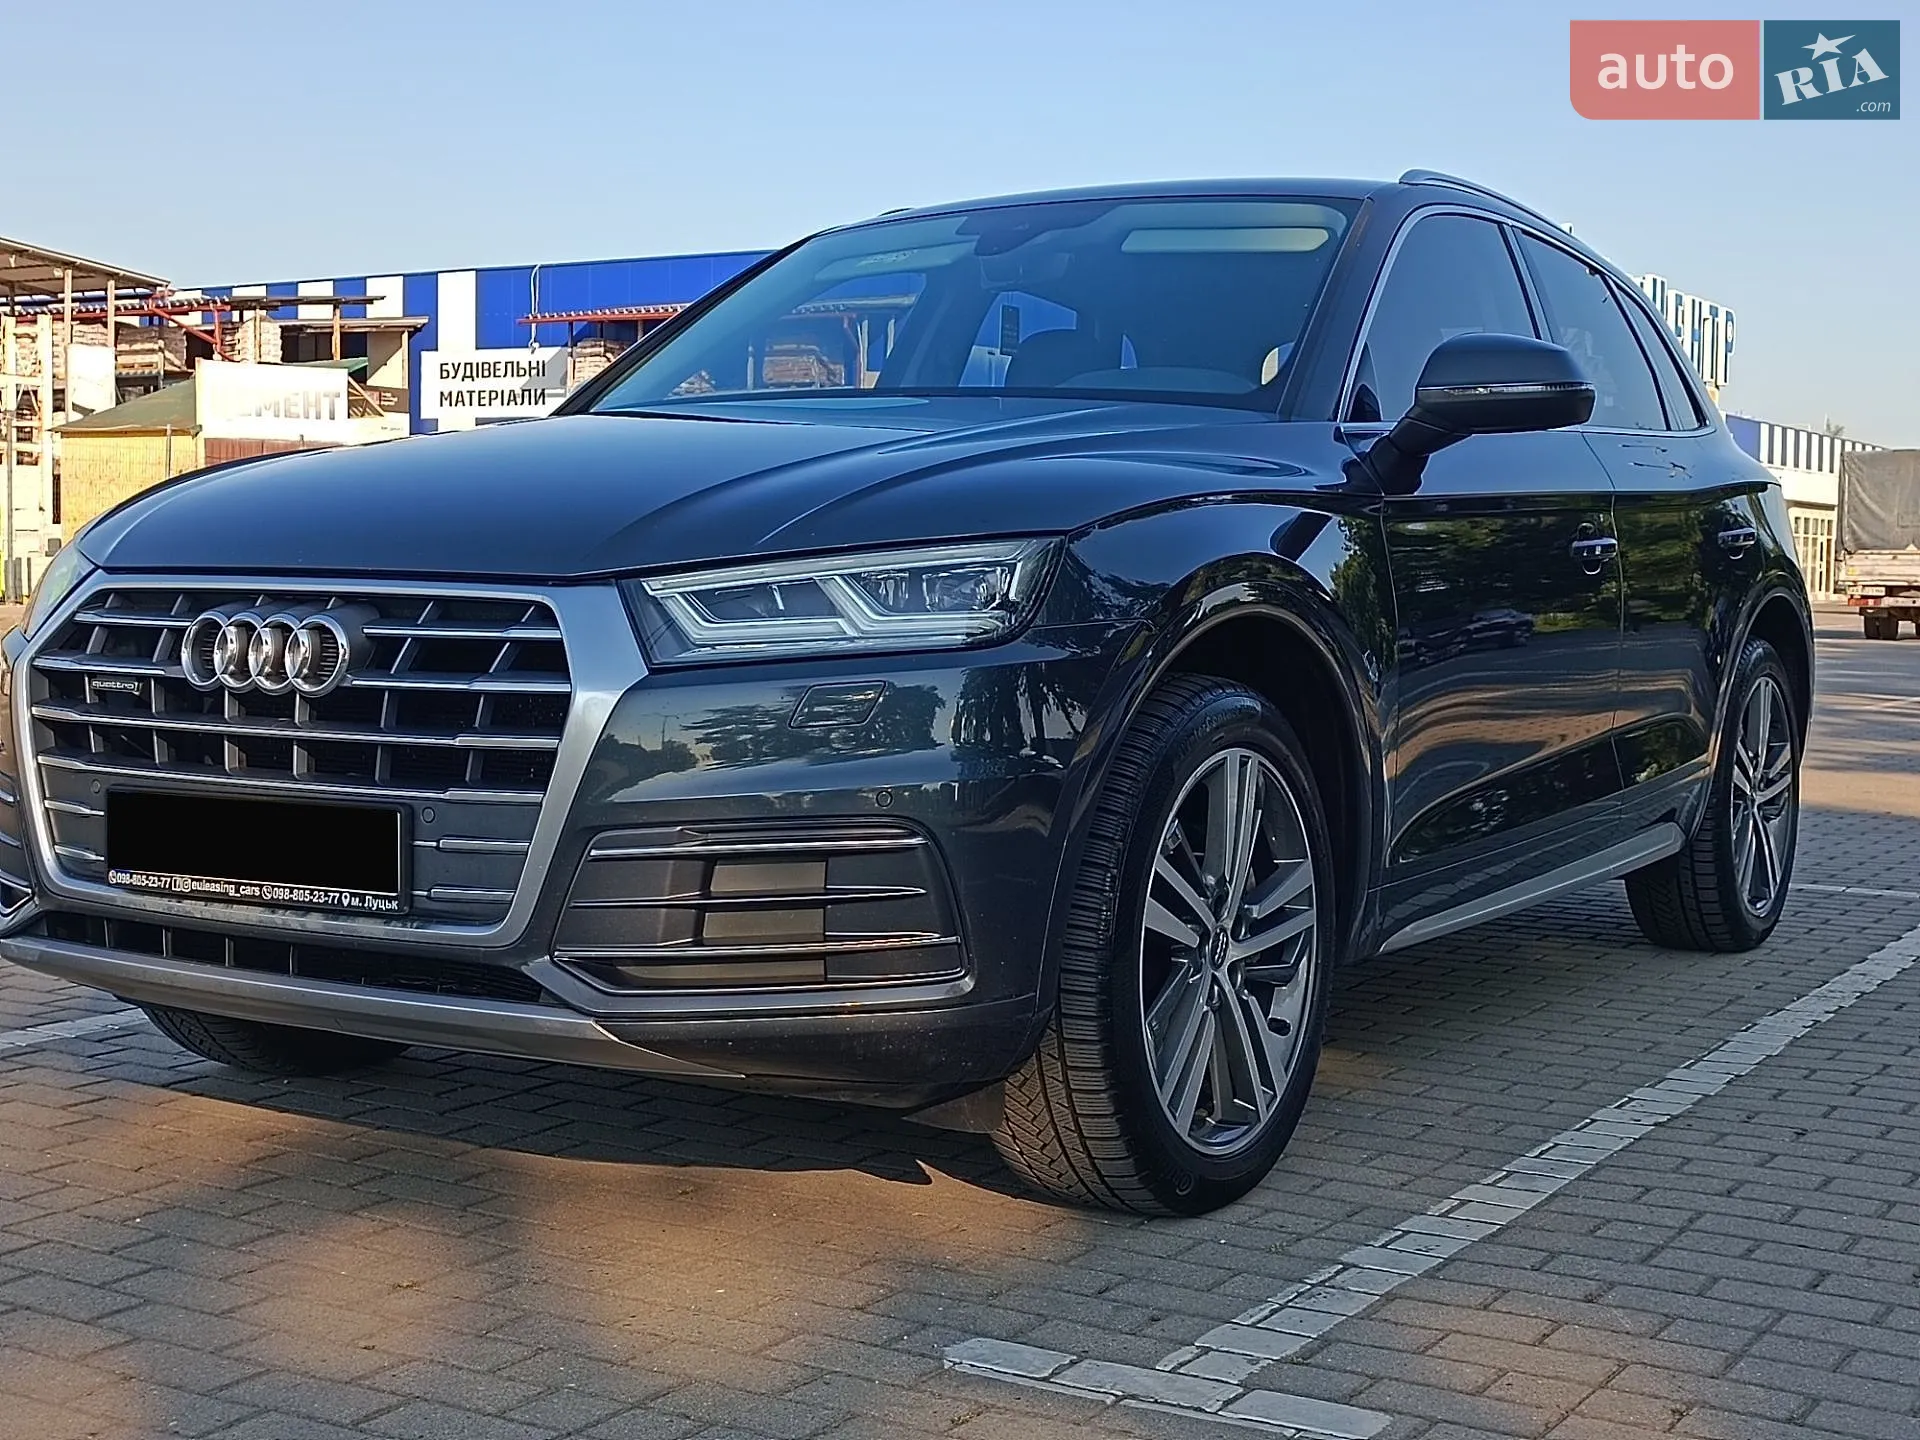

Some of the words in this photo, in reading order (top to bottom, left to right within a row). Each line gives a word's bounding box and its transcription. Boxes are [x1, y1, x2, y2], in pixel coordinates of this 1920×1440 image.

[439, 360, 546, 382] БУДІВЕЛЬНІ
[439, 388, 546, 407] МАТЕРІАЛИ
[92, 680, 135, 690] quattro
[116, 872, 171, 889] 098-805-23-77
[191, 879, 260, 897] euleasing_cars
[272, 887, 340, 904] 098-805-23-77
[364, 895, 399, 910] Луцьк
